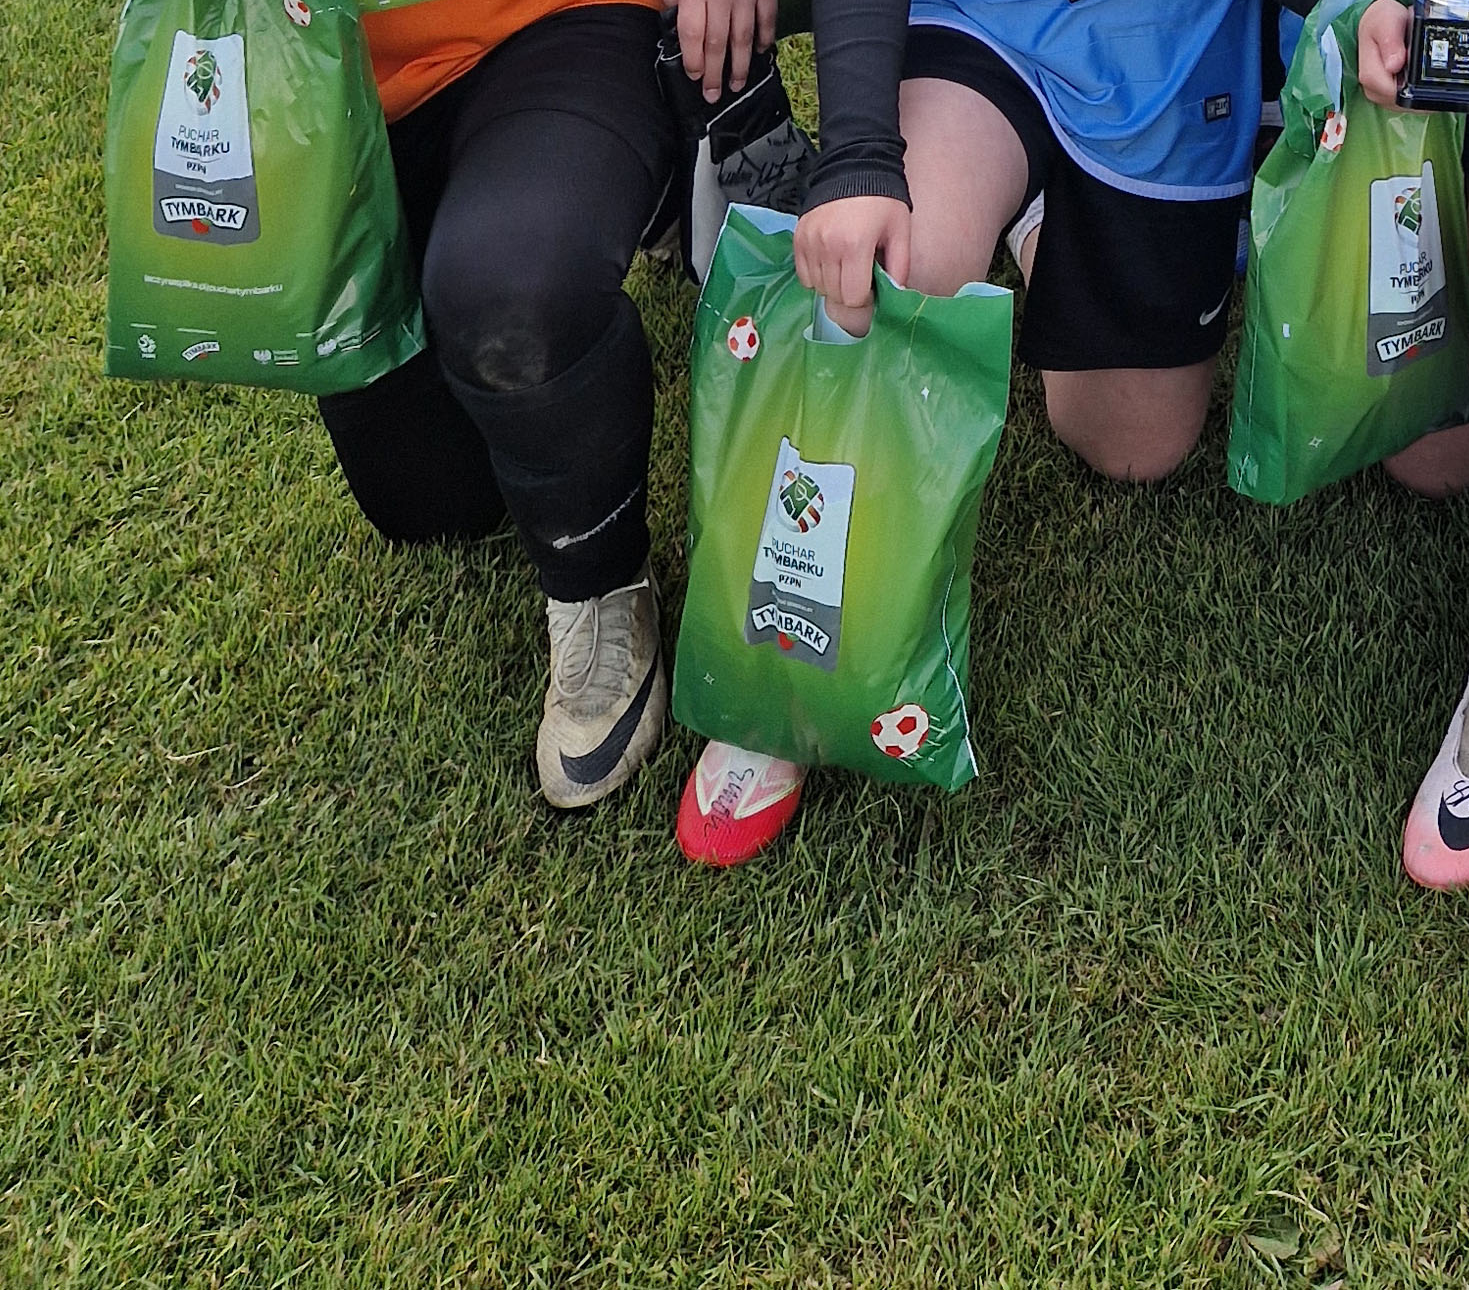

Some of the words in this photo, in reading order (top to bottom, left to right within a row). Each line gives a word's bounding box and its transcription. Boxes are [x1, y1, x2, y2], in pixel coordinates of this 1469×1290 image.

[178, 124, 220, 142] PUCHAR
[171, 136, 230, 157] TYMBARKU
[165, 202, 240, 224] TYMBARK
[1381, 320, 1443, 355] TYMBARK
[763, 546, 824, 577] TYMBARKU
[778, 574, 802, 588] PZPN
